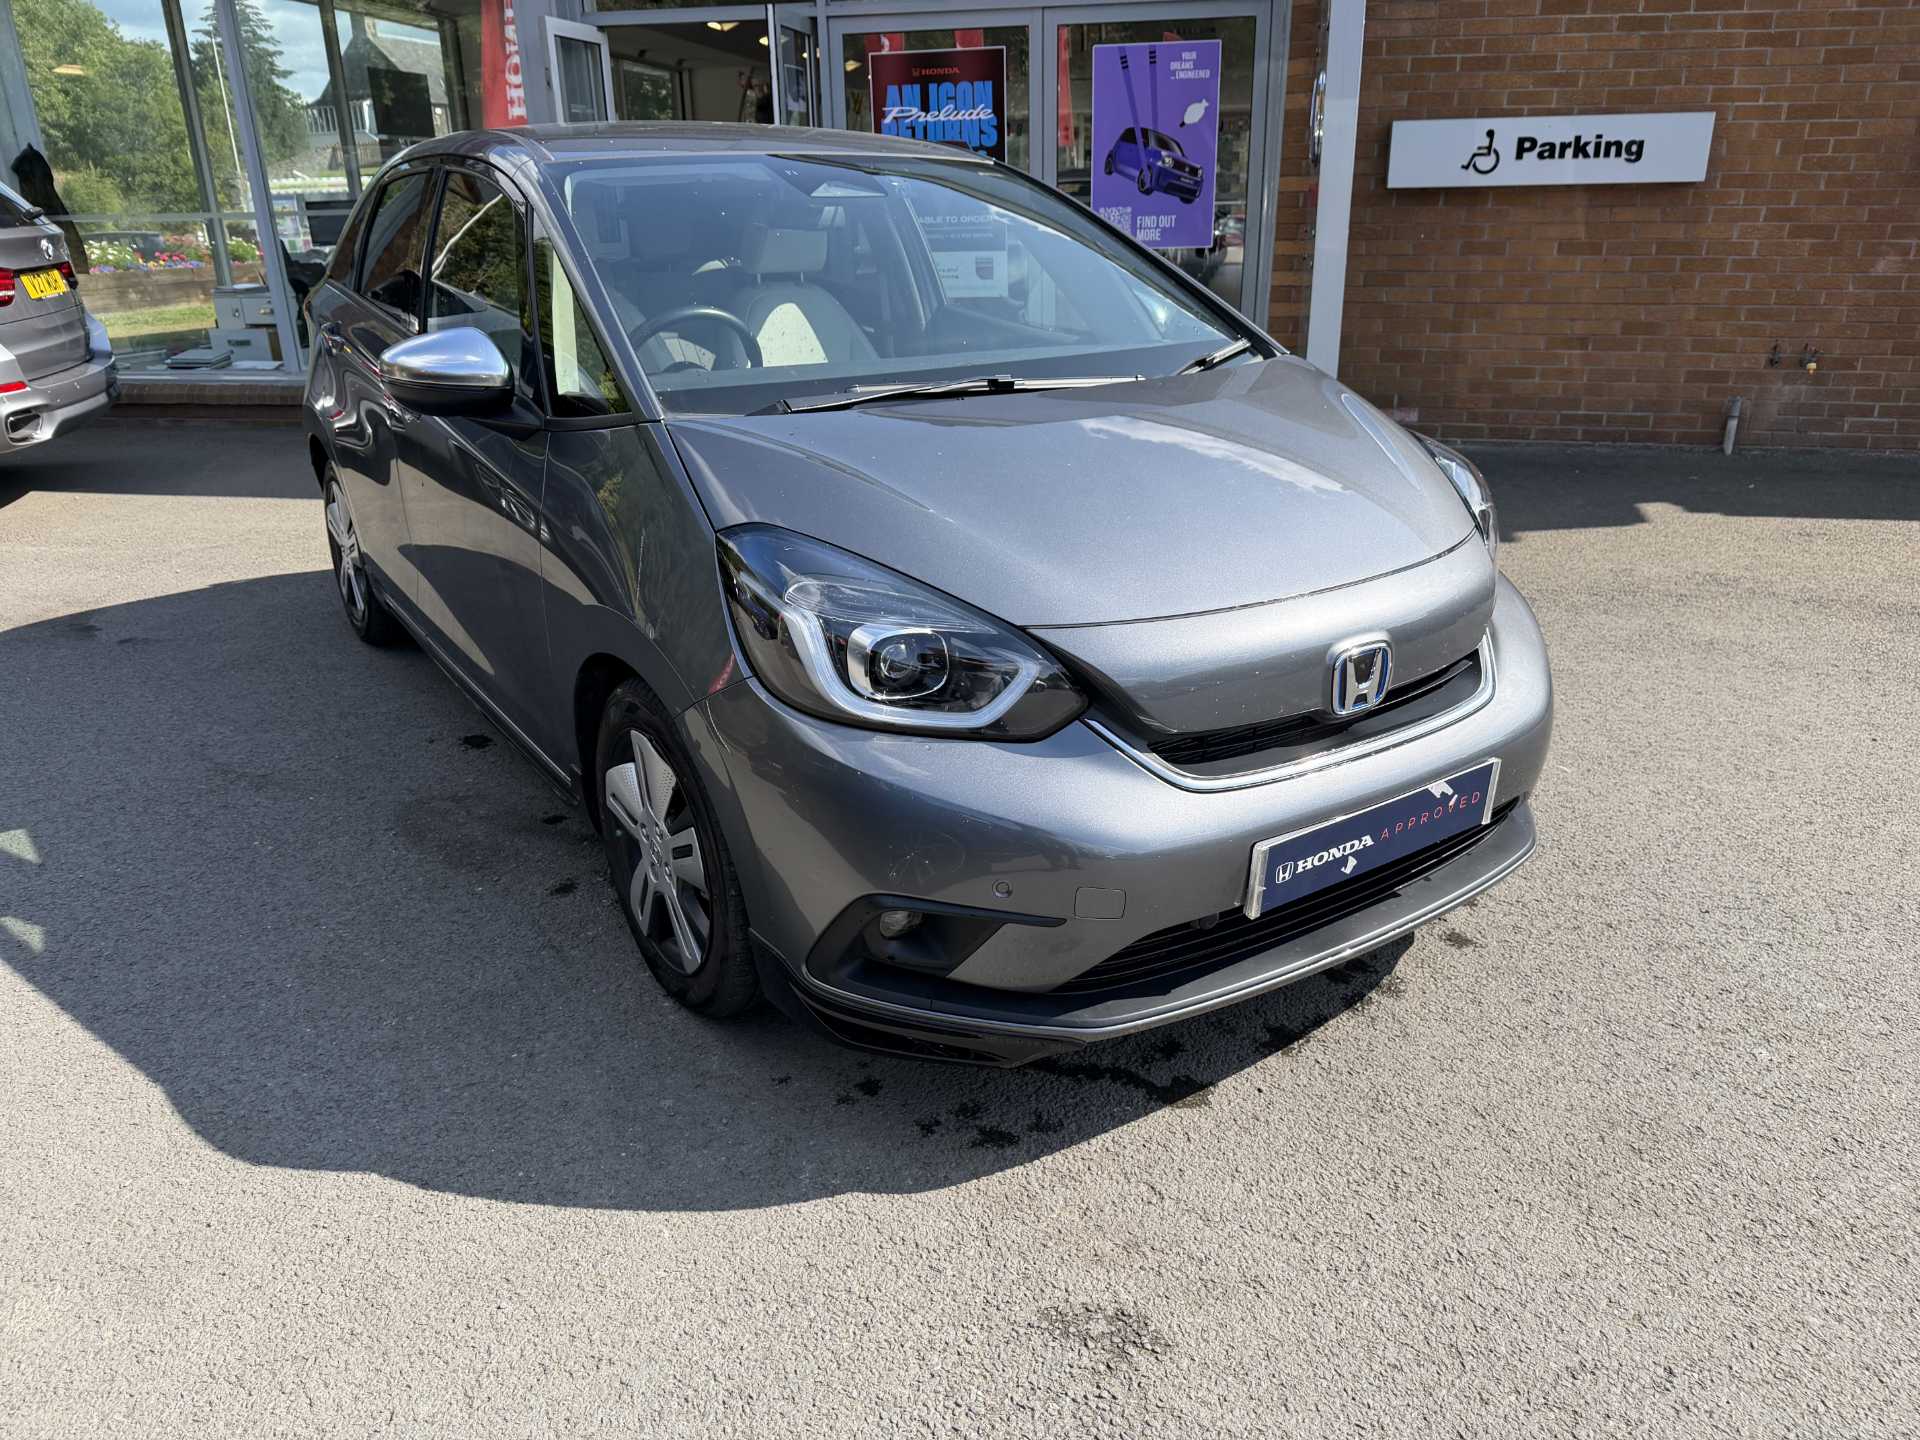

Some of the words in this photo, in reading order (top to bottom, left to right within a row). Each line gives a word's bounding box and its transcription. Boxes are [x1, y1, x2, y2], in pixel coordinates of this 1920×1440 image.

[921, 66, 960, 76] HONDA
[884, 84, 921, 118] AN
[928, 80, 993, 112] ICON
[881, 104, 995, 124] Prelude
[1515, 134, 1645, 163] Parking
[1136, 215, 1157, 228] FIND
[1158, 215, 1176, 227] OUT
[1136, 228, 1162, 240] MORE
[1295, 834, 1375, 874] HONDA
[1380, 791, 1480, 841] APPROVED
